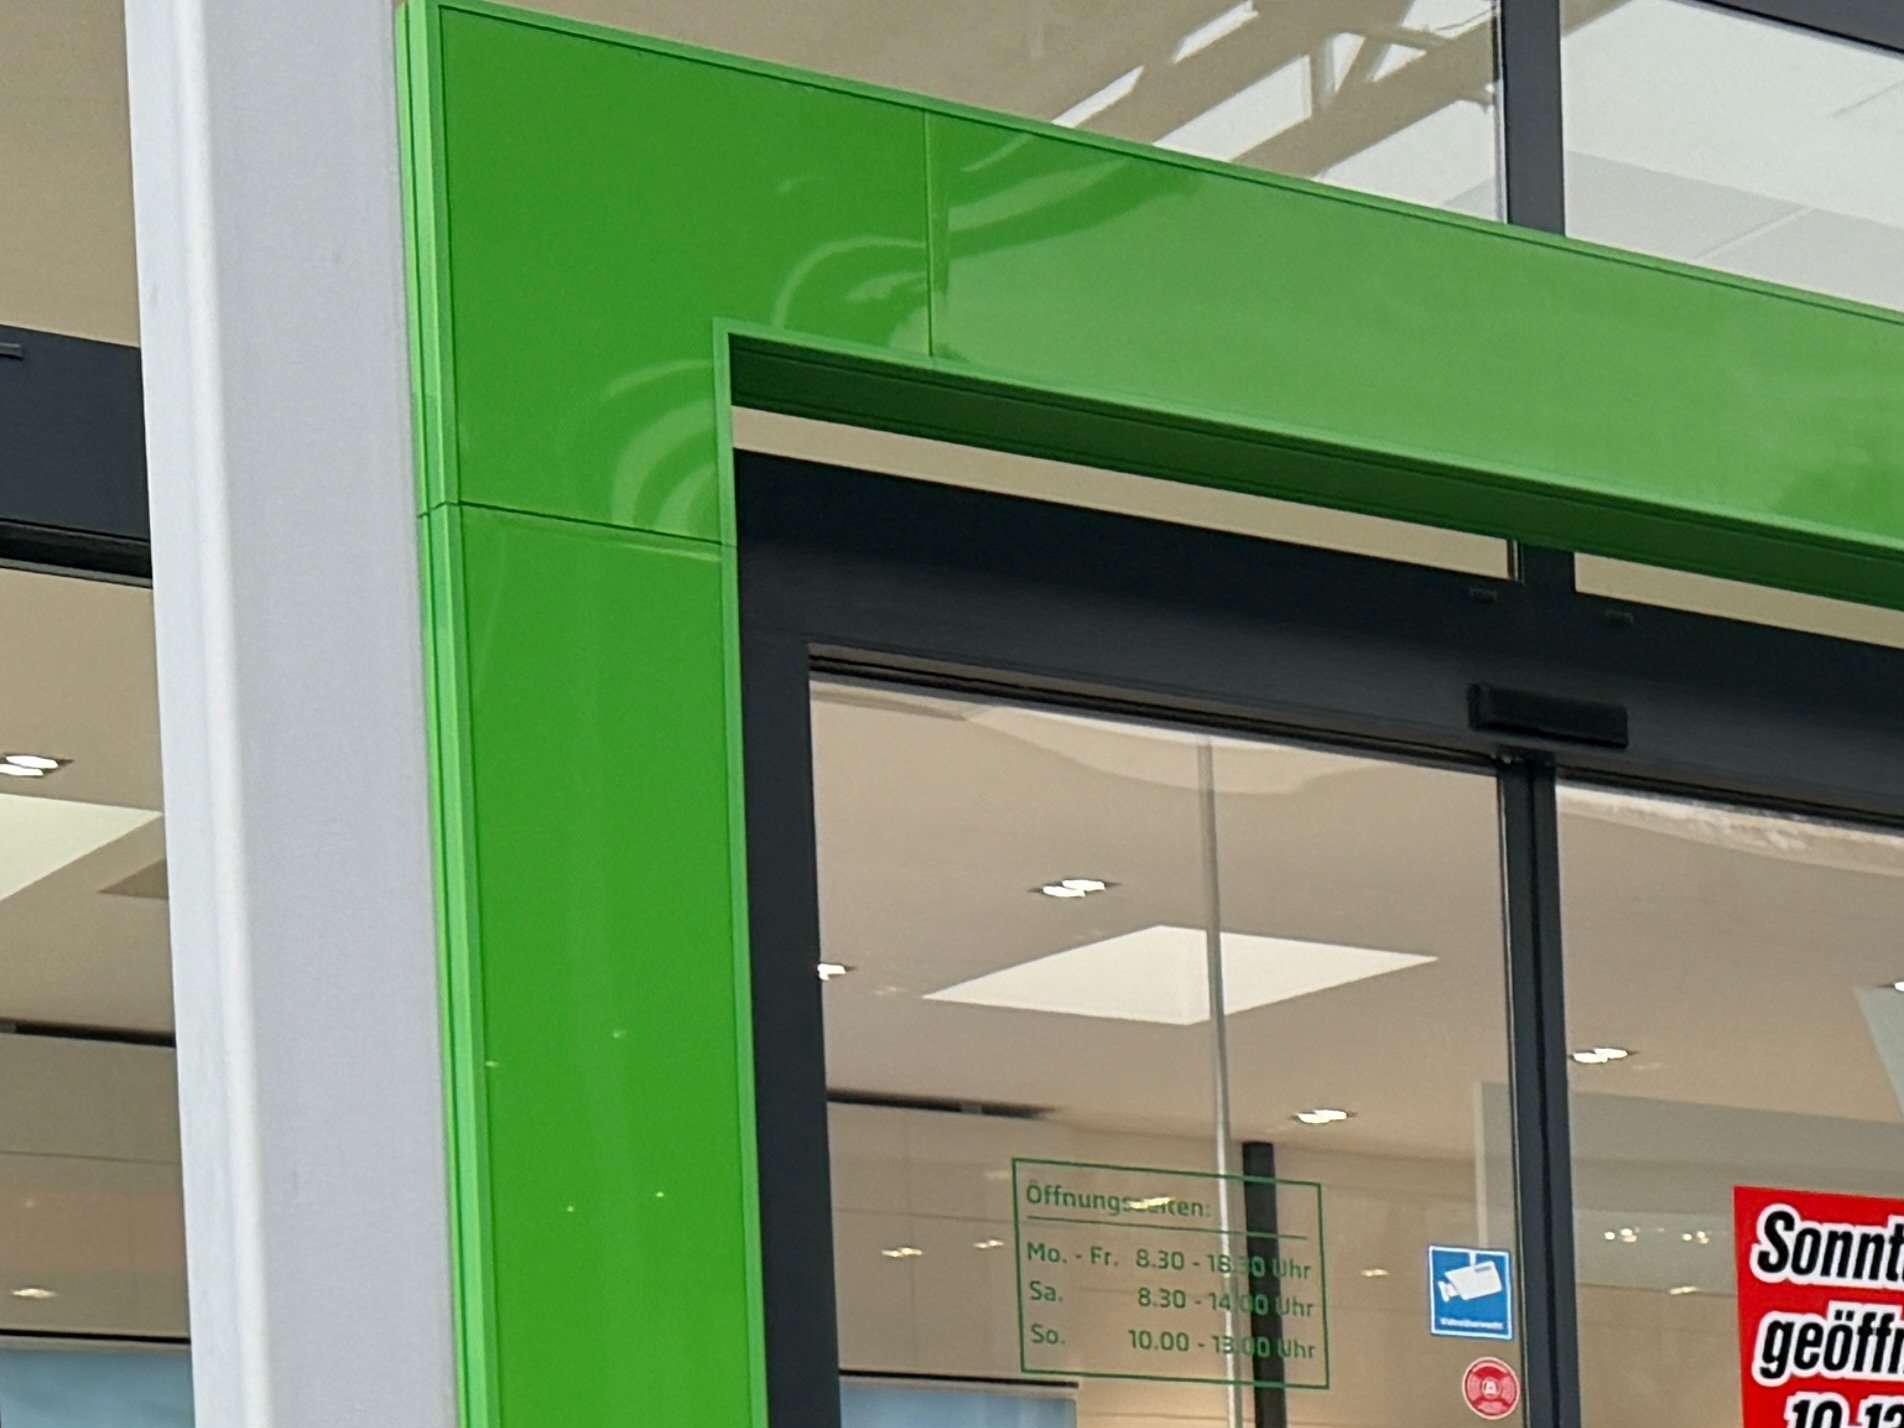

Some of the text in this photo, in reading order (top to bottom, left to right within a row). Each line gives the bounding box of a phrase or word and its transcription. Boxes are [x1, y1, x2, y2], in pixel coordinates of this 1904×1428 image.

[1027, 1242, 1068, 1263] Mo.
[1090, 1247, 1119, 1267] Fr.
[1136, 1249, 1184, 1270] 8.30
[1272, 1258, 1312, 1279] Uhr
[1029, 1281, 1064, 1302] Sa.
[1138, 1288, 1187, 1309] 8.30
[1208, 1292, 1269, 1316] 1400
[1275, 1296, 1314, 1317] Uhr
[1031, 1323, 1066, 1345] So.
[1128, 1330, 1190, 1352] 10.00
[1278, 1339, 1315, 1359] Uhr
